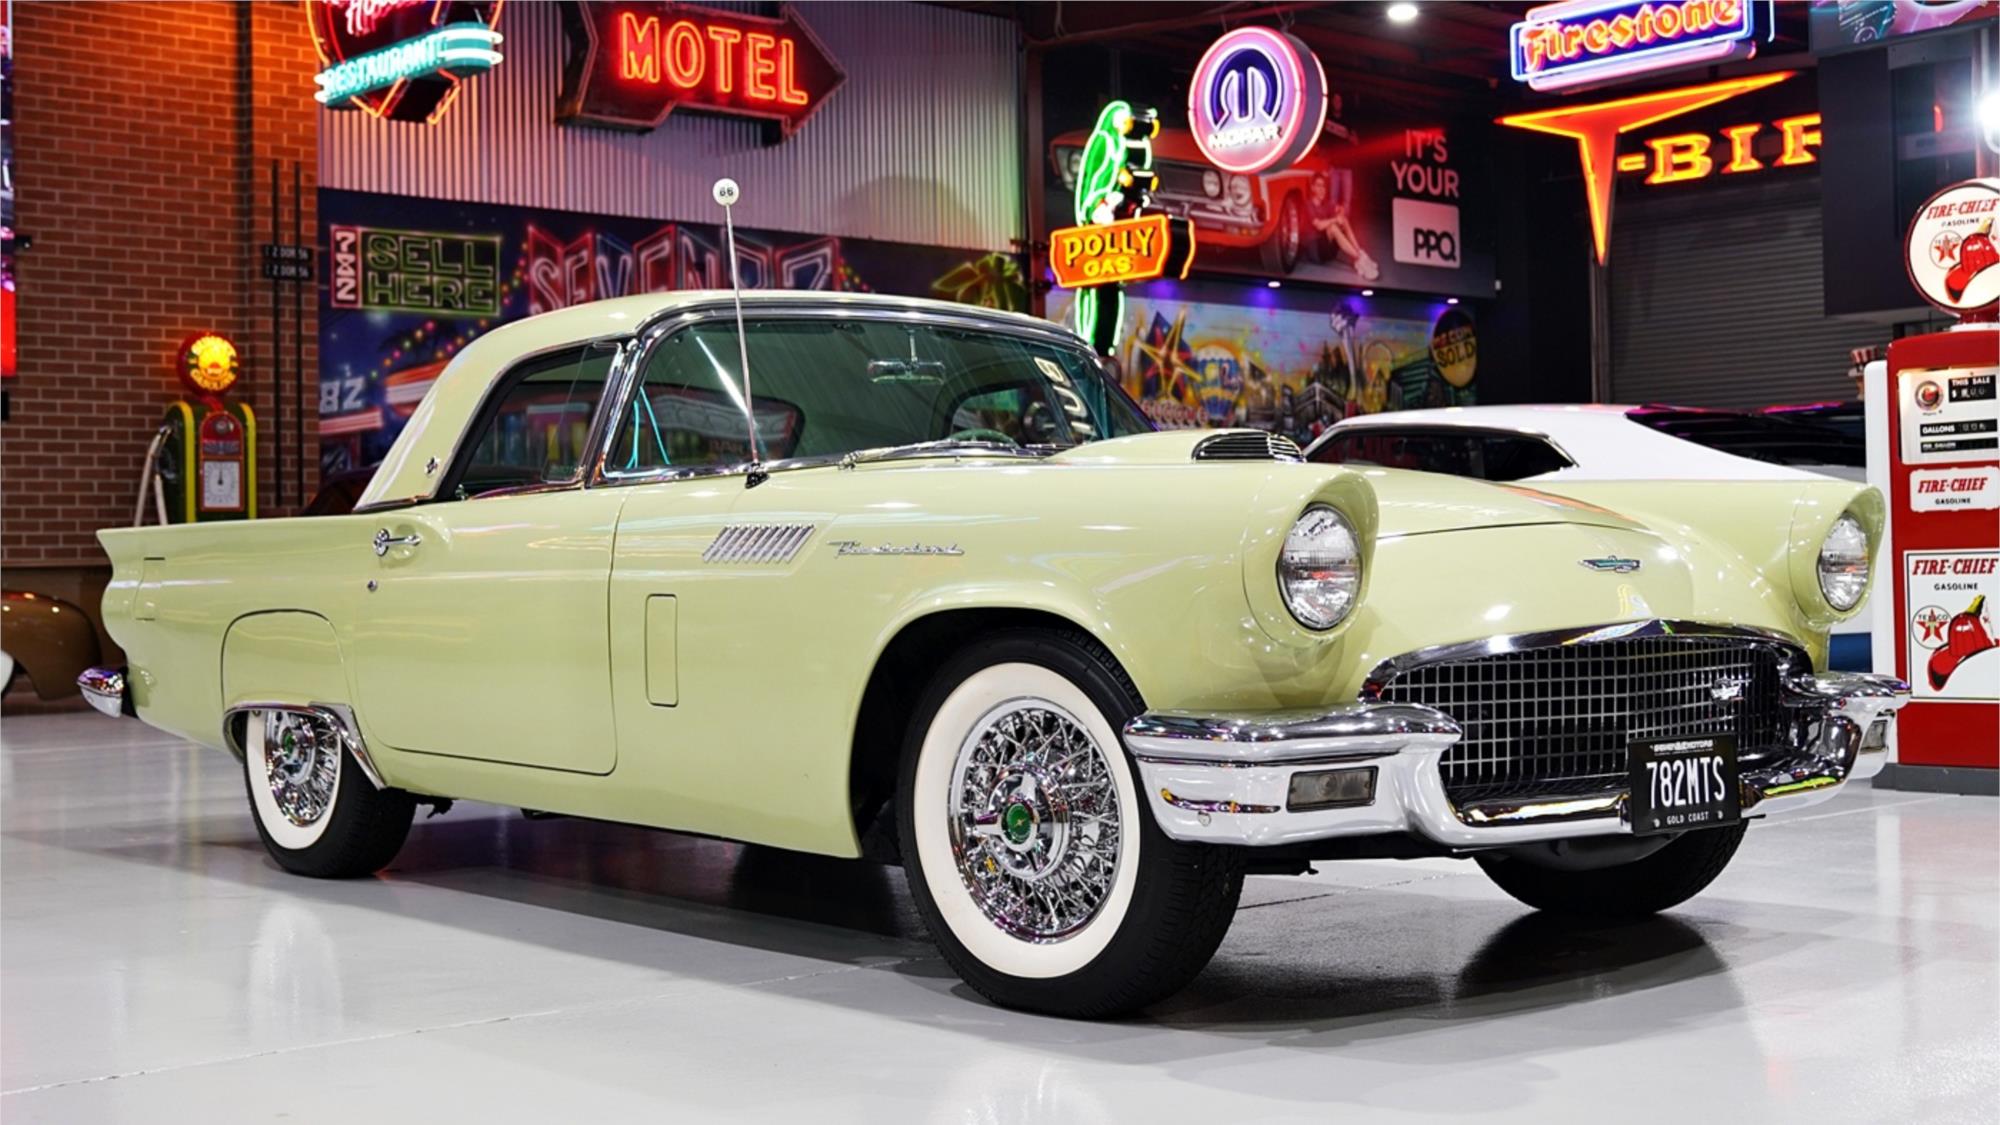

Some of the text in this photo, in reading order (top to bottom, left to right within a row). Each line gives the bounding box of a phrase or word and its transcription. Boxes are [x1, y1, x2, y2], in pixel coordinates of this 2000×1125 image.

[1521, 0, 1741, 72] Firestone
[323, 34, 442, 97] RESTAURANT
[620, 12, 808, 105] MOTEL
[1208, 123, 1282, 149] MOPAR
[1405, 128, 1448, 163] IT'S
[1391, 160, 1460, 198] YOUR
[1926, 198, 1999, 220] FIRE-CHIEF
[367, 233, 493, 277] SELL
[1063, 226, 1155, 266] POLLY
[1413, 226, 1457, 262] PPQ
[1083, 255, 1132, 277] GAS
[367, 270, 494, 310] HERE
[1436, 341, 1475, 368] SOLD
[1973, 376, 1990, 385] SALE
[1922, 424, 1956, 434] GALLONS
[1917, 477, 1988, 494] FIRE-CHIEF
[1912, 558, 1999, 575] FIRE-CHIEF
[1934, 583, 1979, 591] GASOLINE
[1646, 755, 1726, 810] 782MTS
[1666, 811, 1710, 825] GOLD COAST
